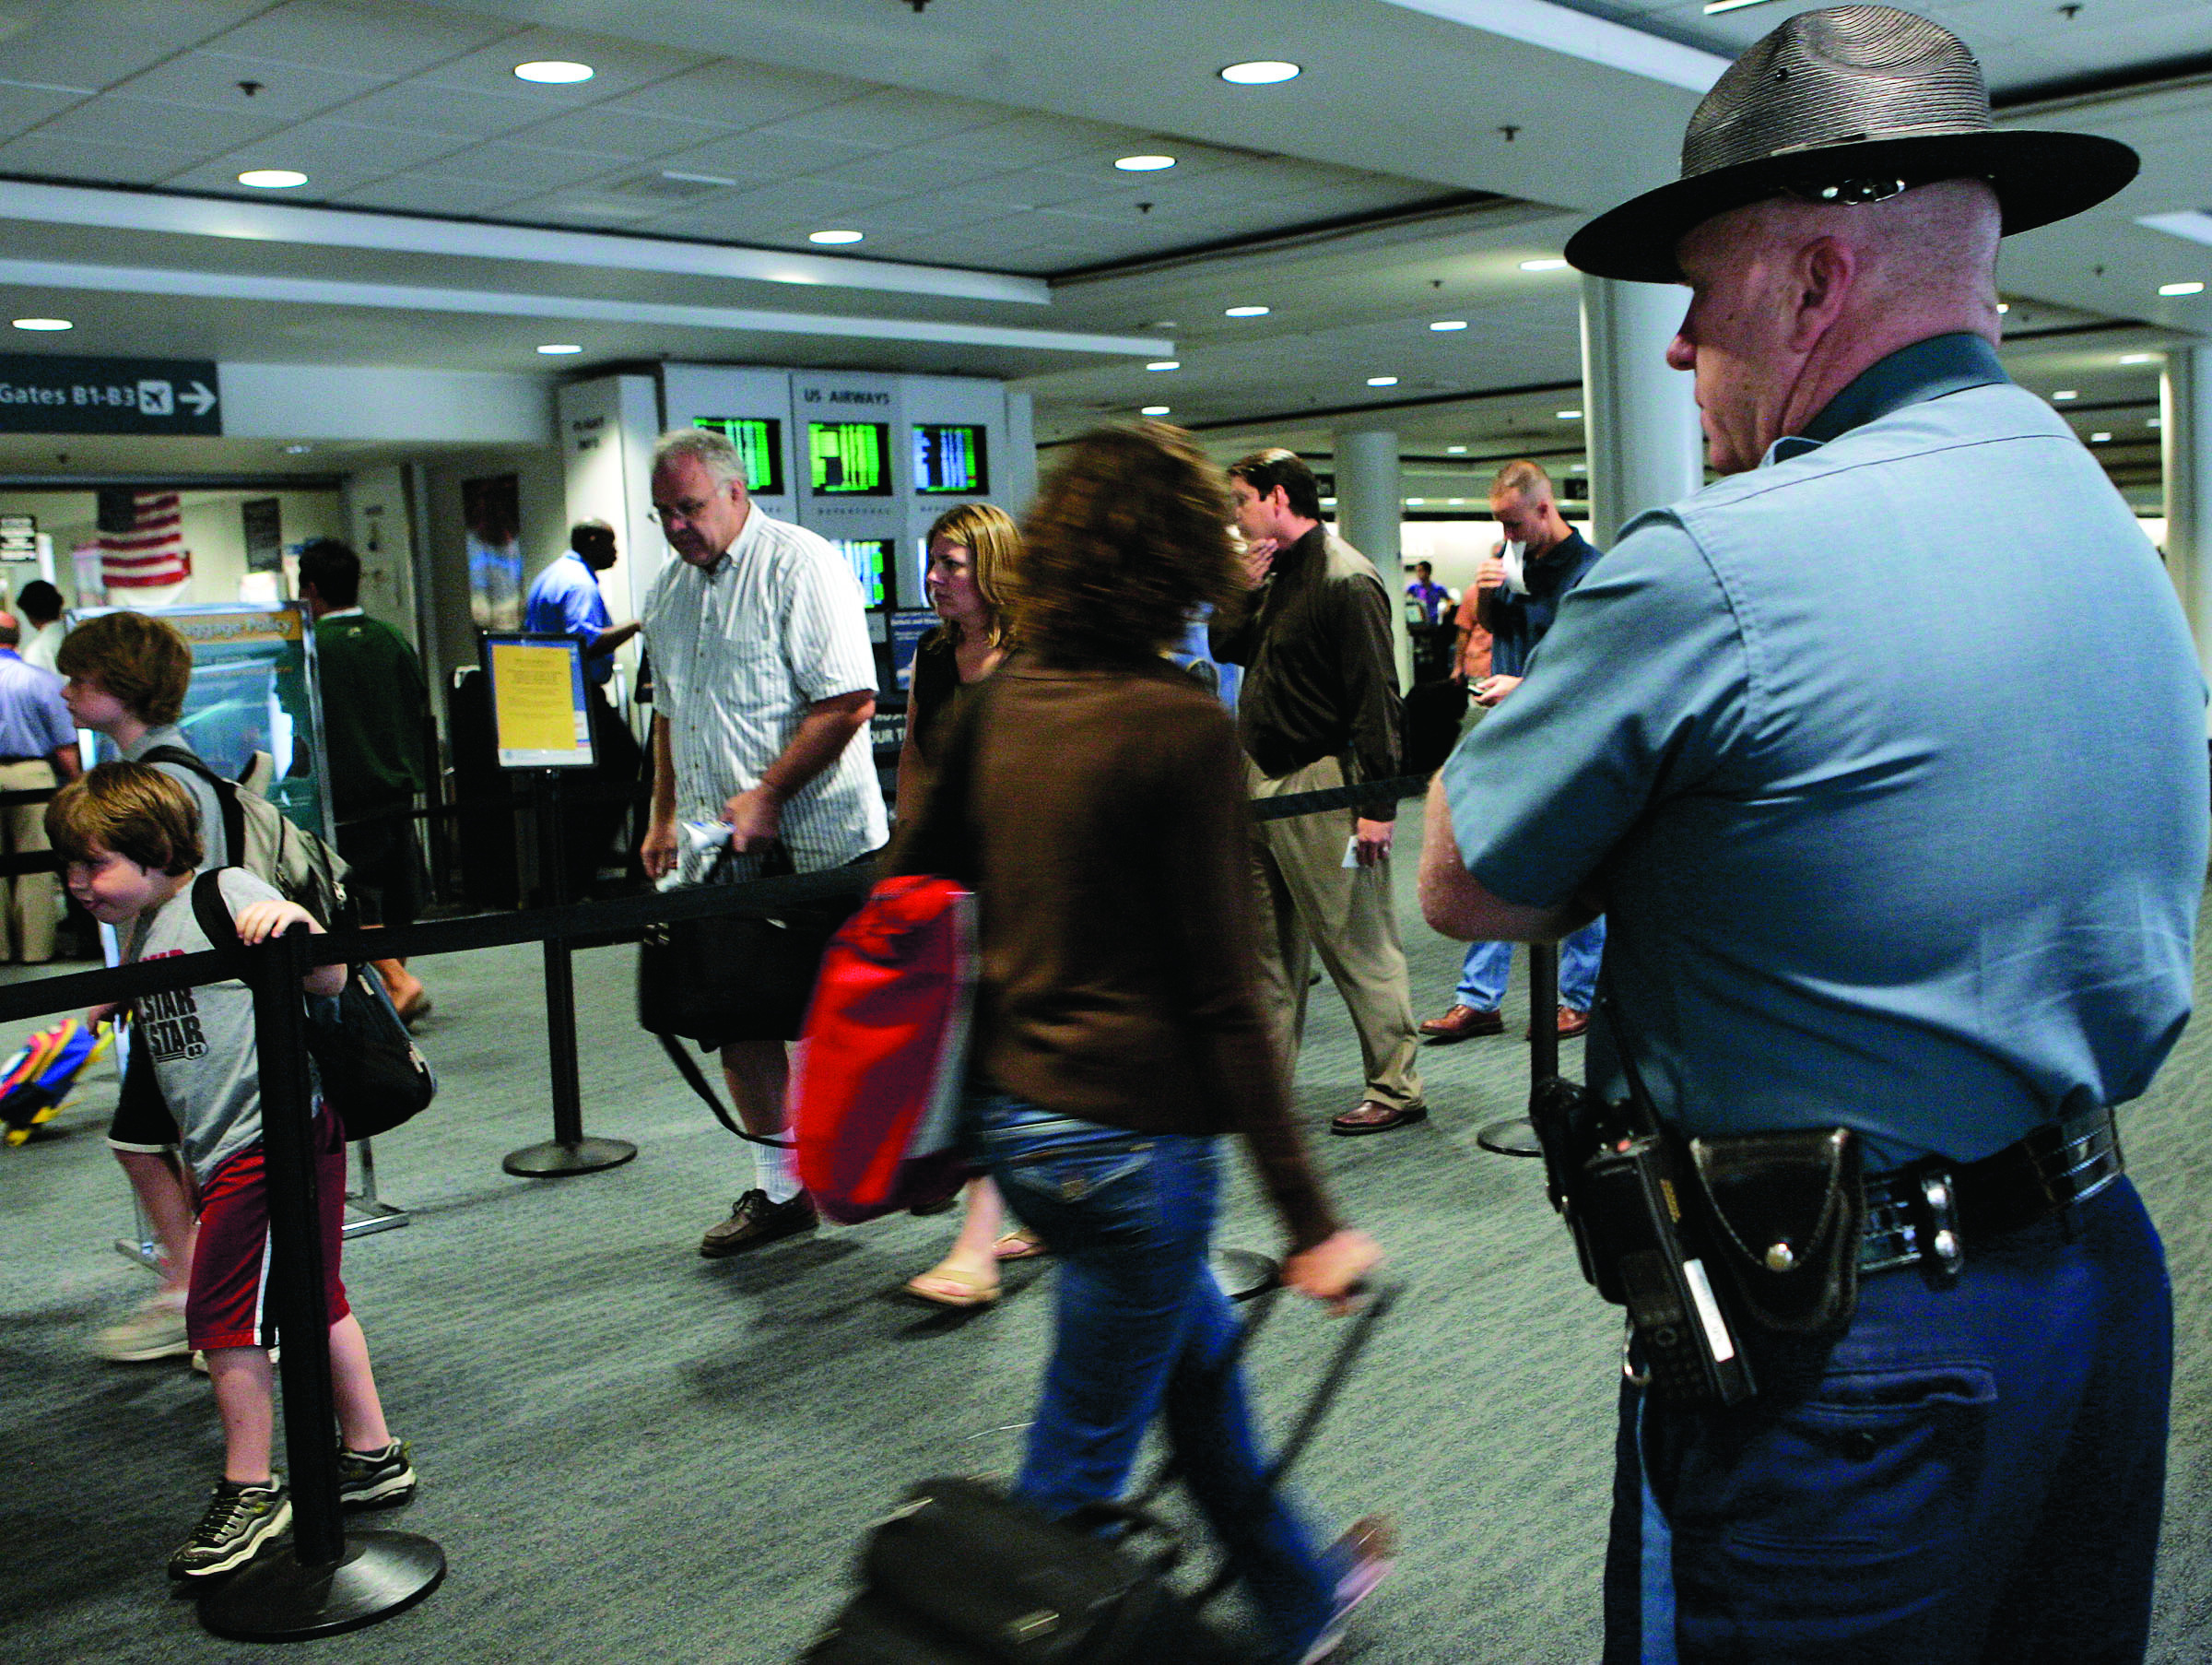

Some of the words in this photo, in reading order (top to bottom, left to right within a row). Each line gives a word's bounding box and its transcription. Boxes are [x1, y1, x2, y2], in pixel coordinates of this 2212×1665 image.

[0, 383, 66, 404] Gates
[804, 388, 821, 403] US
[830, 391, 889, 404] AIRWAYS
[149, 1016, 206, 1057] STAR
